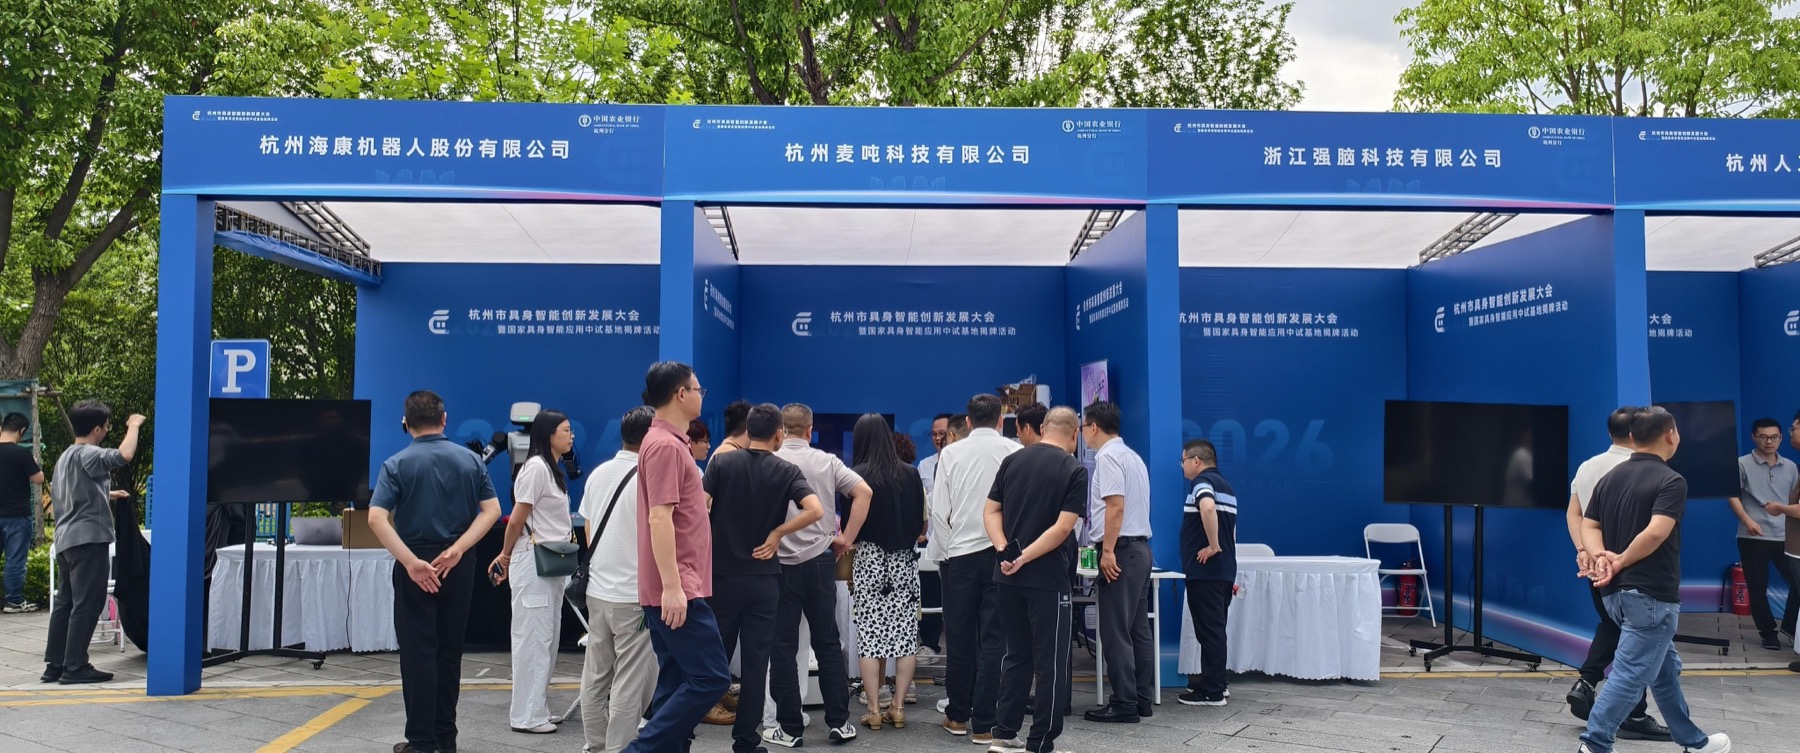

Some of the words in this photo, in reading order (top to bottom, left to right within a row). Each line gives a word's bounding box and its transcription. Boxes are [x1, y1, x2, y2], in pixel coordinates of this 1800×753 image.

[259, 135, 570, 160] 杭州海康机器人股份有限公司
[785, 143, 1030, 165] 杭州麦吨科技有限公司
[1263, 146, 1501, 168] 浙江强脑科技有限公司
[1725, 153, 1800, 173] 杭州人
[1453, 283, 1553, 316] 杭州市具身智能创新发展大会
[468, 309, 640, 321] 杭州市具身智能创新发展大会
[830, 311, 995, 323] 杭州市具身智能创新发展大会
[1649, 313, 1672, 325] 大会
[858, 326, 1016, 336] 暨国家具身智能应用中试基地揭牌活动
[1203, 327, 1359, 338] 暨国家具身智能应用中试基地揭牌活动
[222, 349, 256, 393] P
